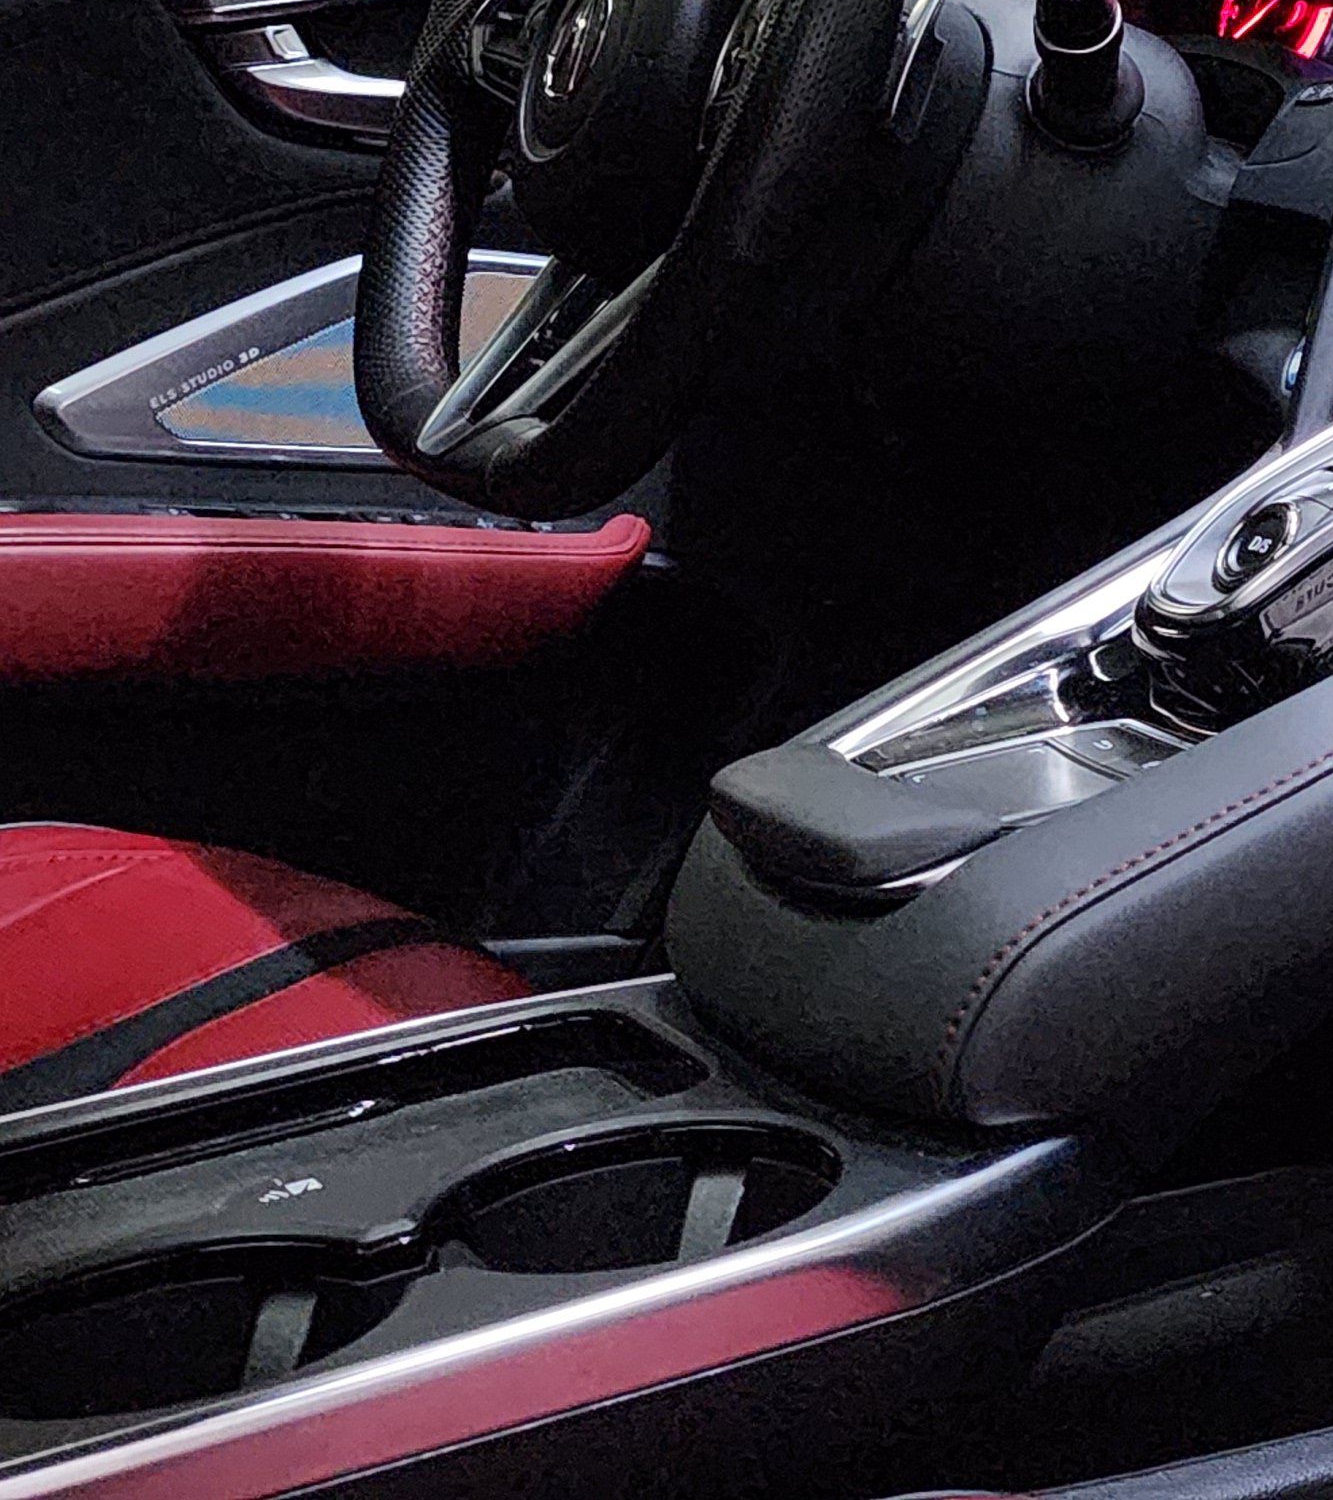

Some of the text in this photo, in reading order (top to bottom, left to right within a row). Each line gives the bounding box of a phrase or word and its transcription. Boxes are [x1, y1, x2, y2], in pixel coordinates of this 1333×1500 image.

[149, 346, 260, 409] ELS STUDIO 3D
[1248, 535, 1272, 554] D/S
